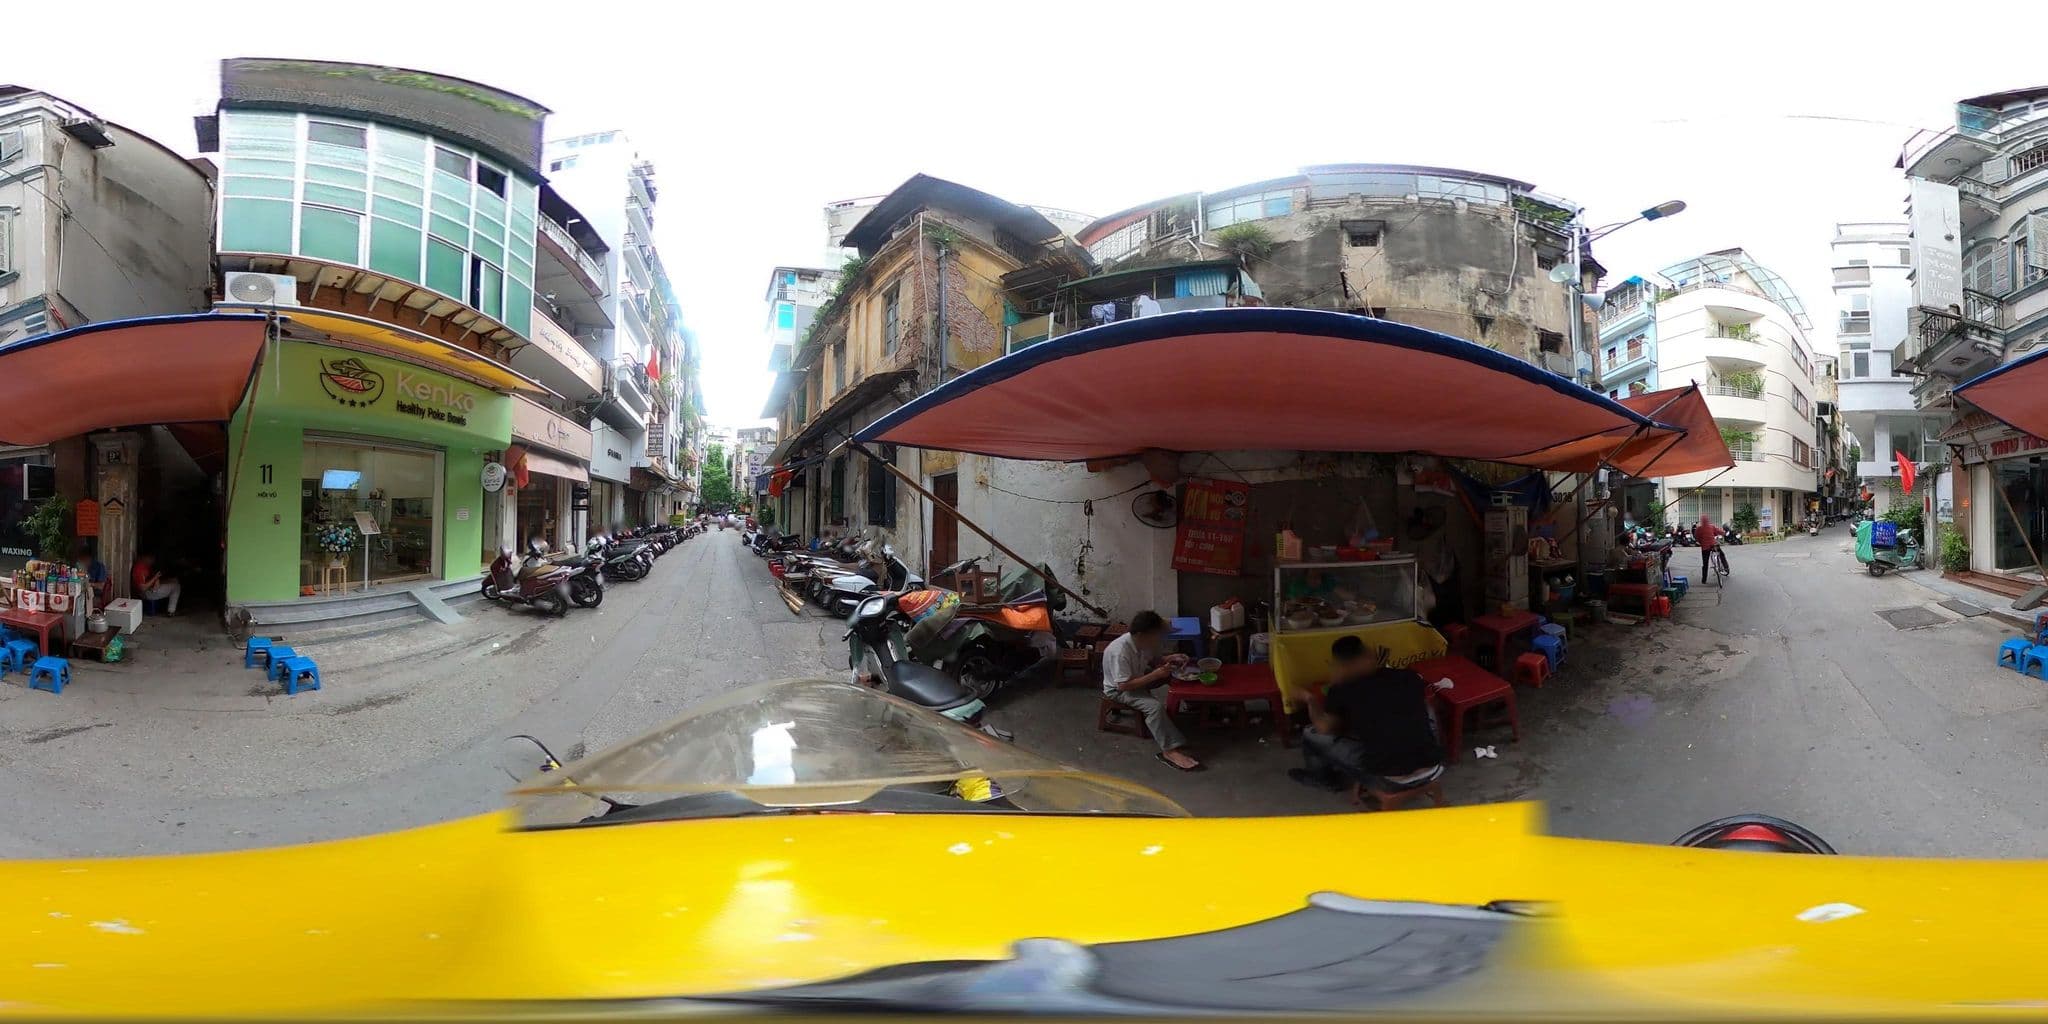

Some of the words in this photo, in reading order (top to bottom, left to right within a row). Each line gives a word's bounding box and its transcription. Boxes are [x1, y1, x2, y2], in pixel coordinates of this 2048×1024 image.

[396, 400, 426, 420] Healthy
[427, 409, 446, 422] Poke
[447, 412, 467, 426] Bowls
[259, 463, 273, 485] 11
[1, 545, 33, 557] WAXING
